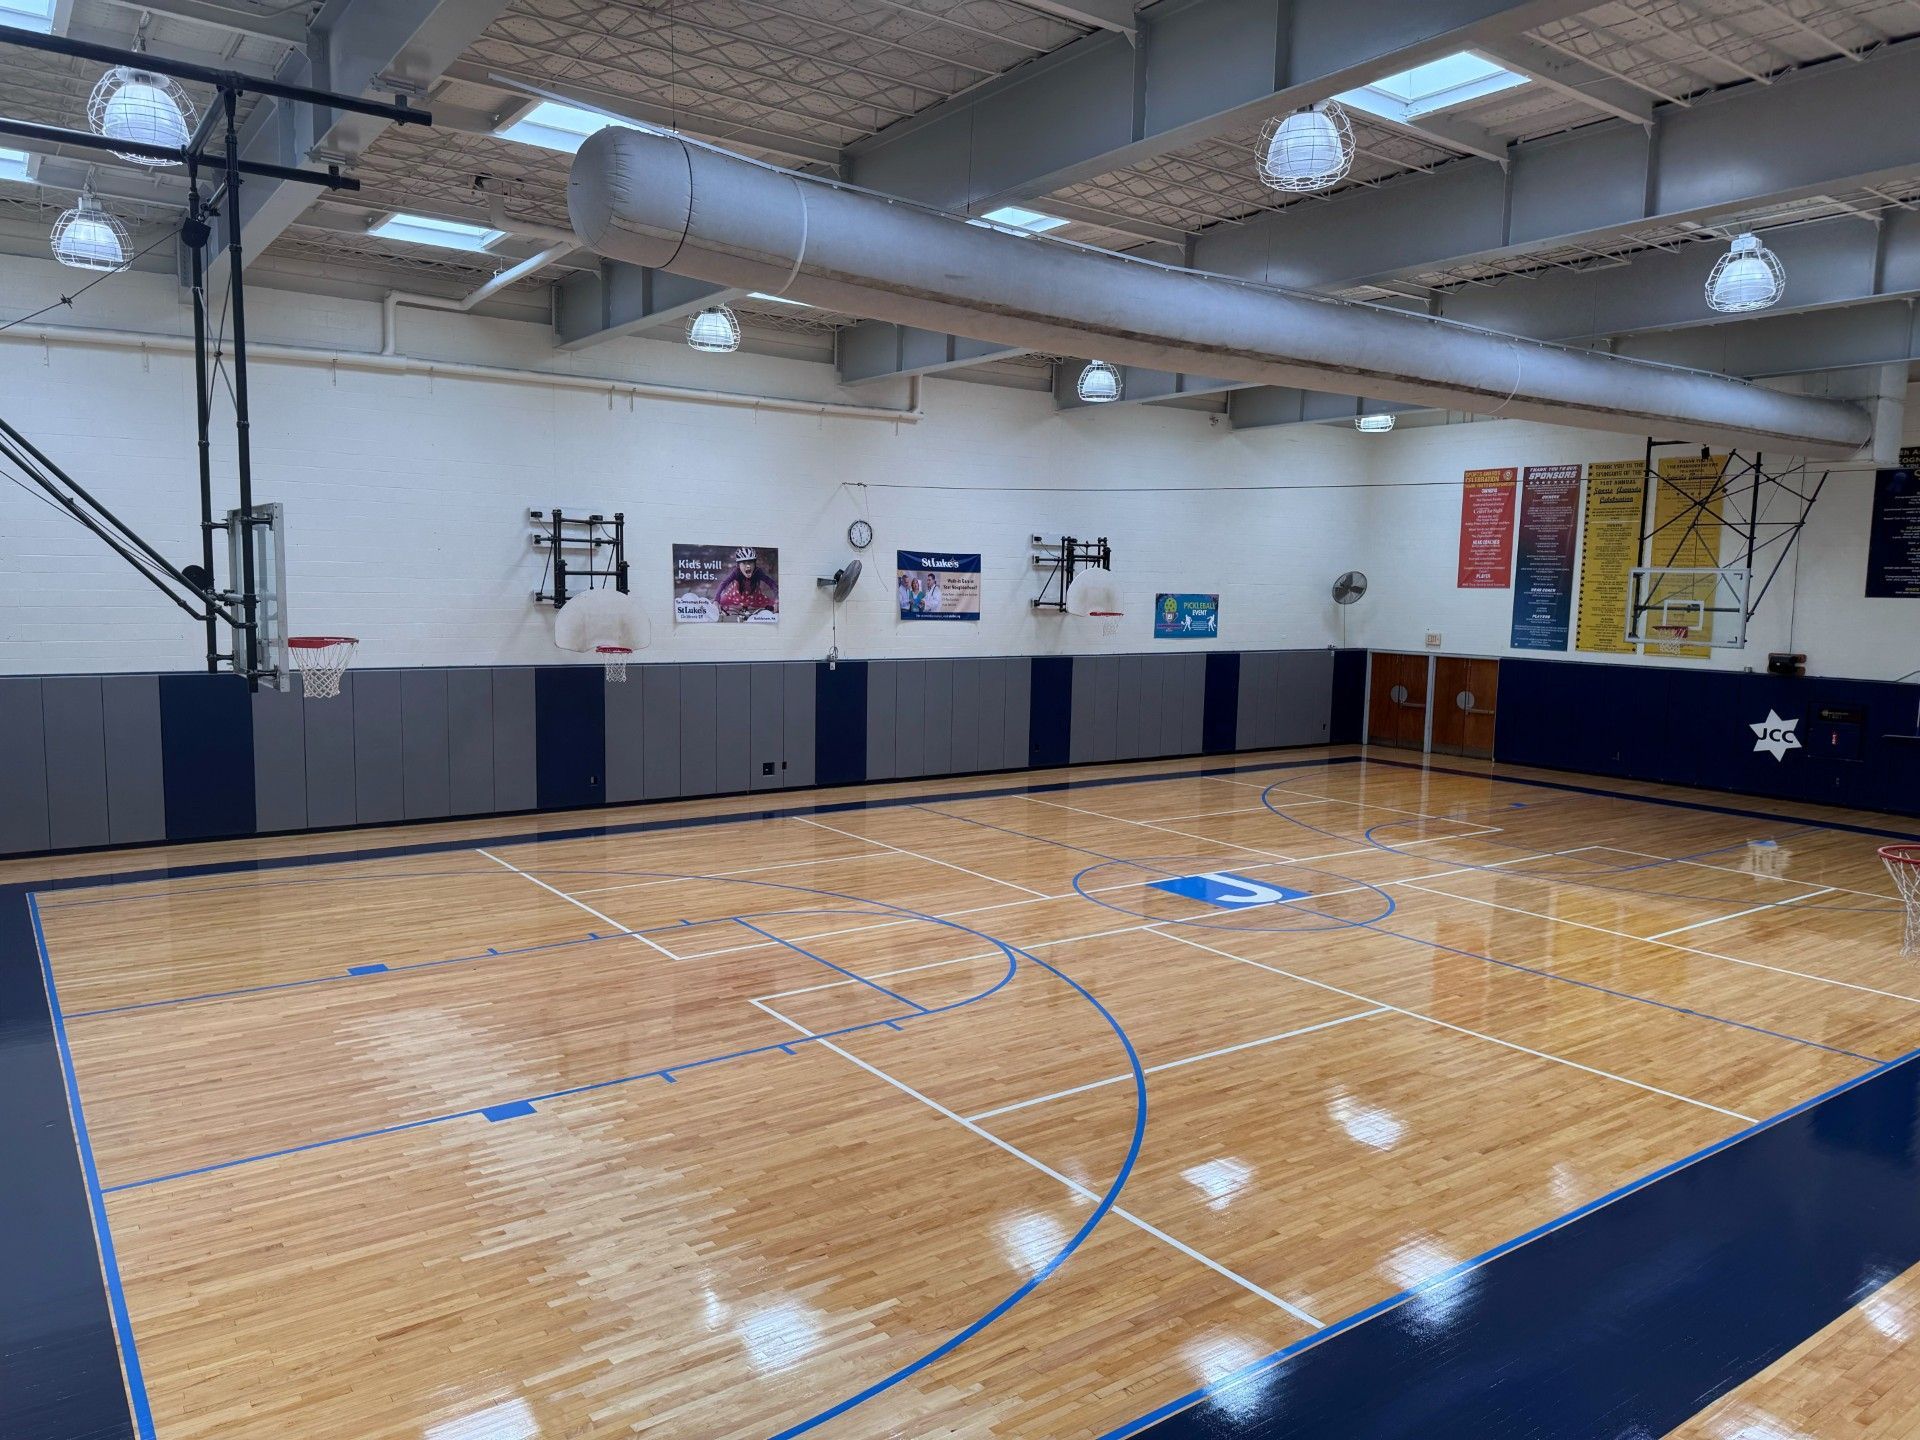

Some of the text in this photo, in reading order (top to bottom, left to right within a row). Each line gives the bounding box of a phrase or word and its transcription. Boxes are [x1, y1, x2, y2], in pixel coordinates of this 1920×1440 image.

[1529, 471, 1577, 480] SPONSORS
[678, 560, 722, 570] Kids will
[678, 571, 717, 580] be kids.
[1758, 728, 1794, 744] JCC
